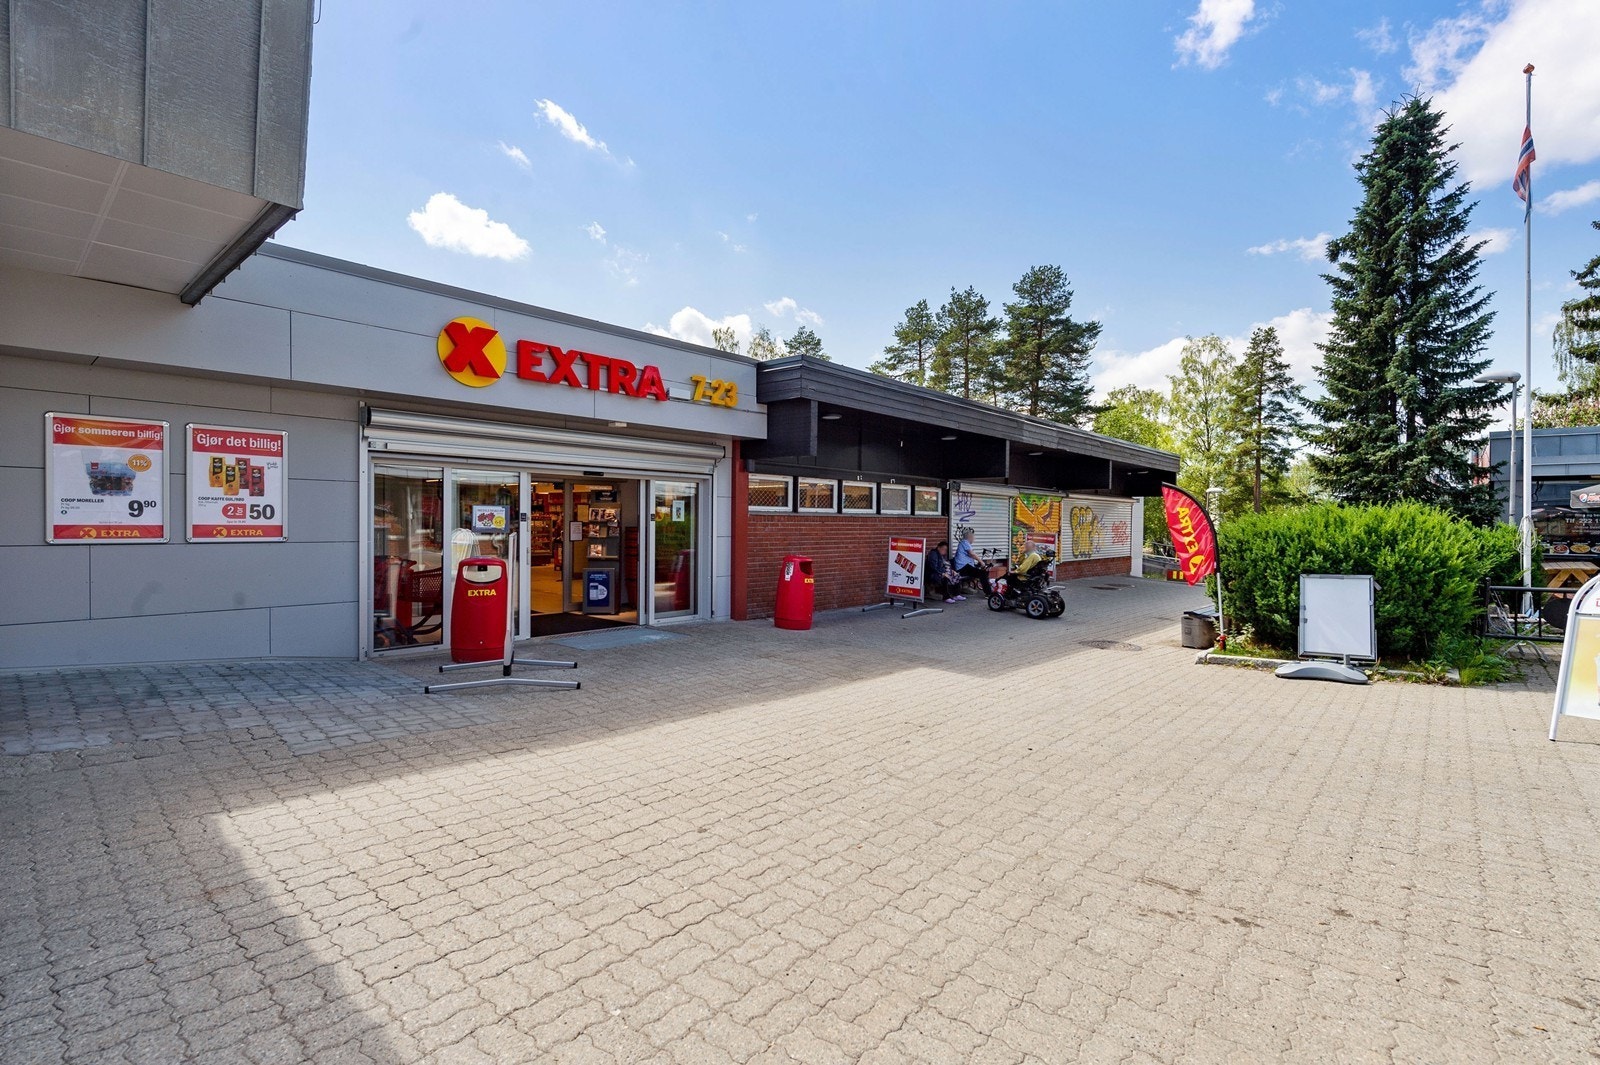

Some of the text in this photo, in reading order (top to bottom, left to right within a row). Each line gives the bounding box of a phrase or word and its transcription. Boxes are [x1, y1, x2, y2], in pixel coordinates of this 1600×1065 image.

[516, 338, 670, 402] EXTRA
[690, 375, 739, 409] 7-23
[53, 423, 164, 441] Gjør sommeren billig!
[197, 433, 282, 452] Gjør det billig!
[227, 506, 234, 516] 2
[249, 504, 275, 520] 50
[101, 529, 141, 538] EXTRA
[230, 529, 263, 537] EXTRA
[467, 588, 497, 597] EXTRA
